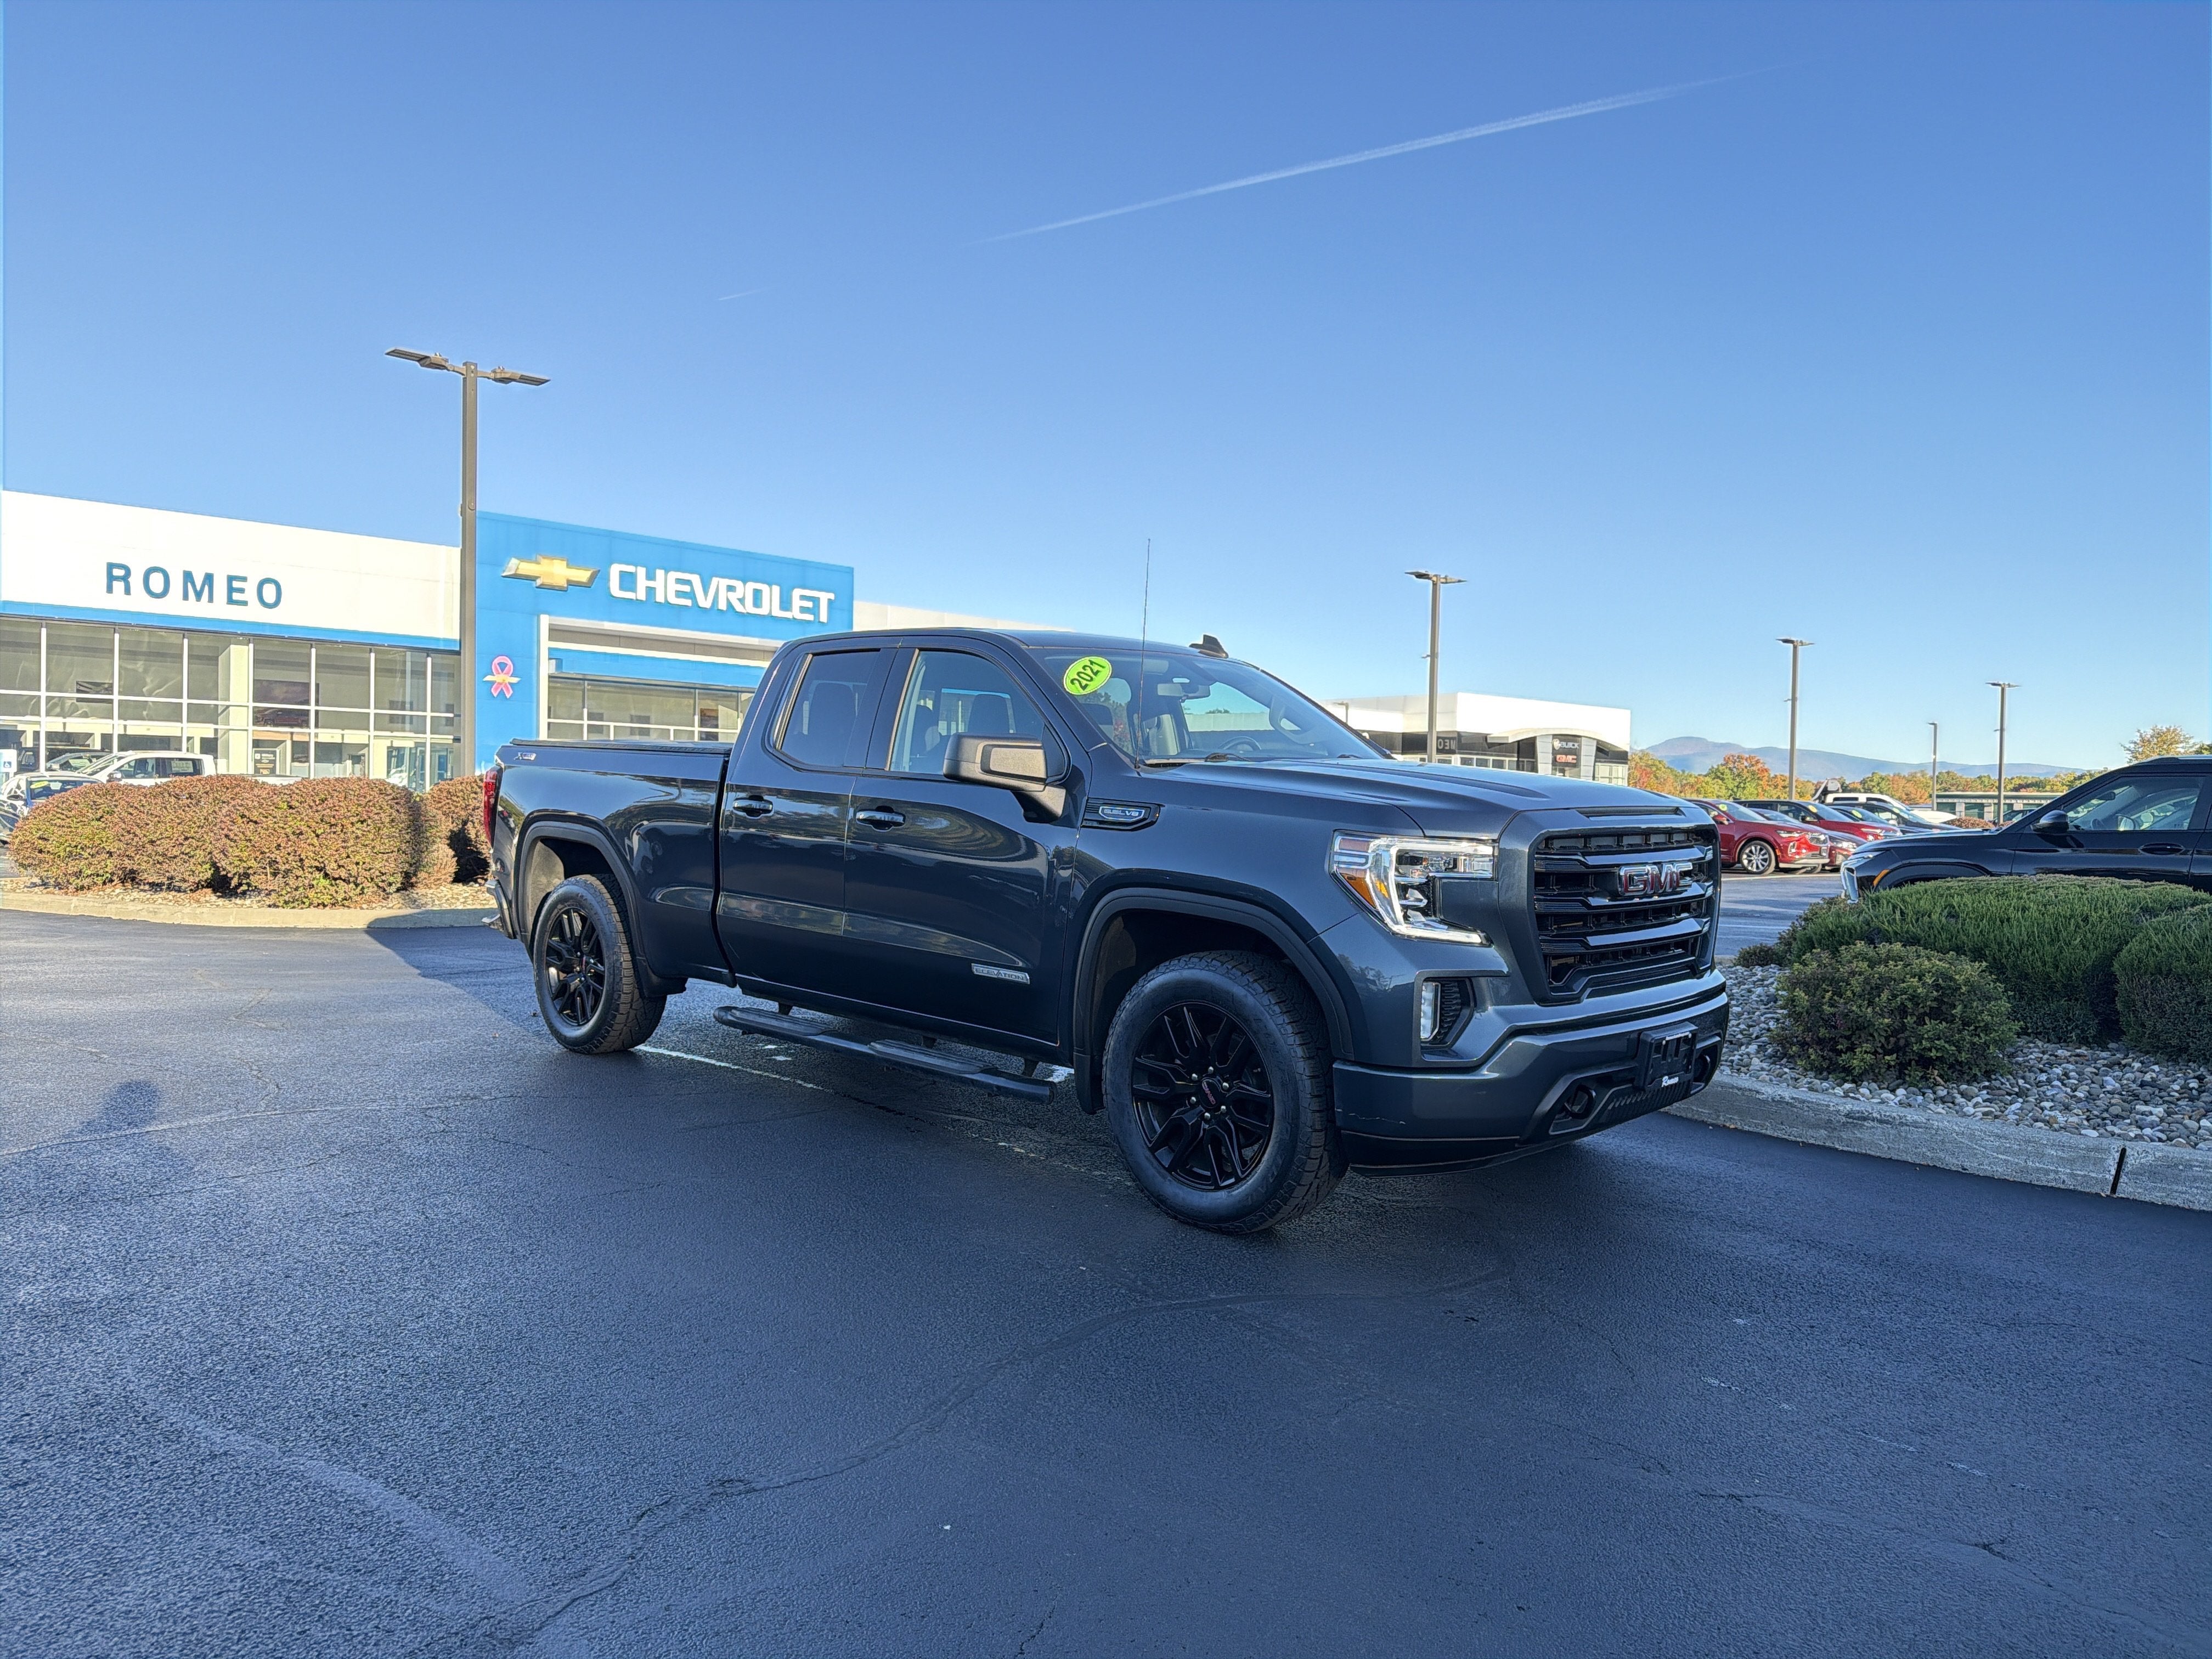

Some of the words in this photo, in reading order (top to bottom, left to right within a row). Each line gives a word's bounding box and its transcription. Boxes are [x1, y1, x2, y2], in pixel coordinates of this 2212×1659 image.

[106, 562, 282, 609] ROMEO
[608, 563, 835, 623] CHEVROLET
[1070, 659, 1107, 691] 2021
[1556, 754, 1577, 763] GMC
[1619, 862, 1693, 896] GMC
[975, 968, 1024, 980] ELEVATION
